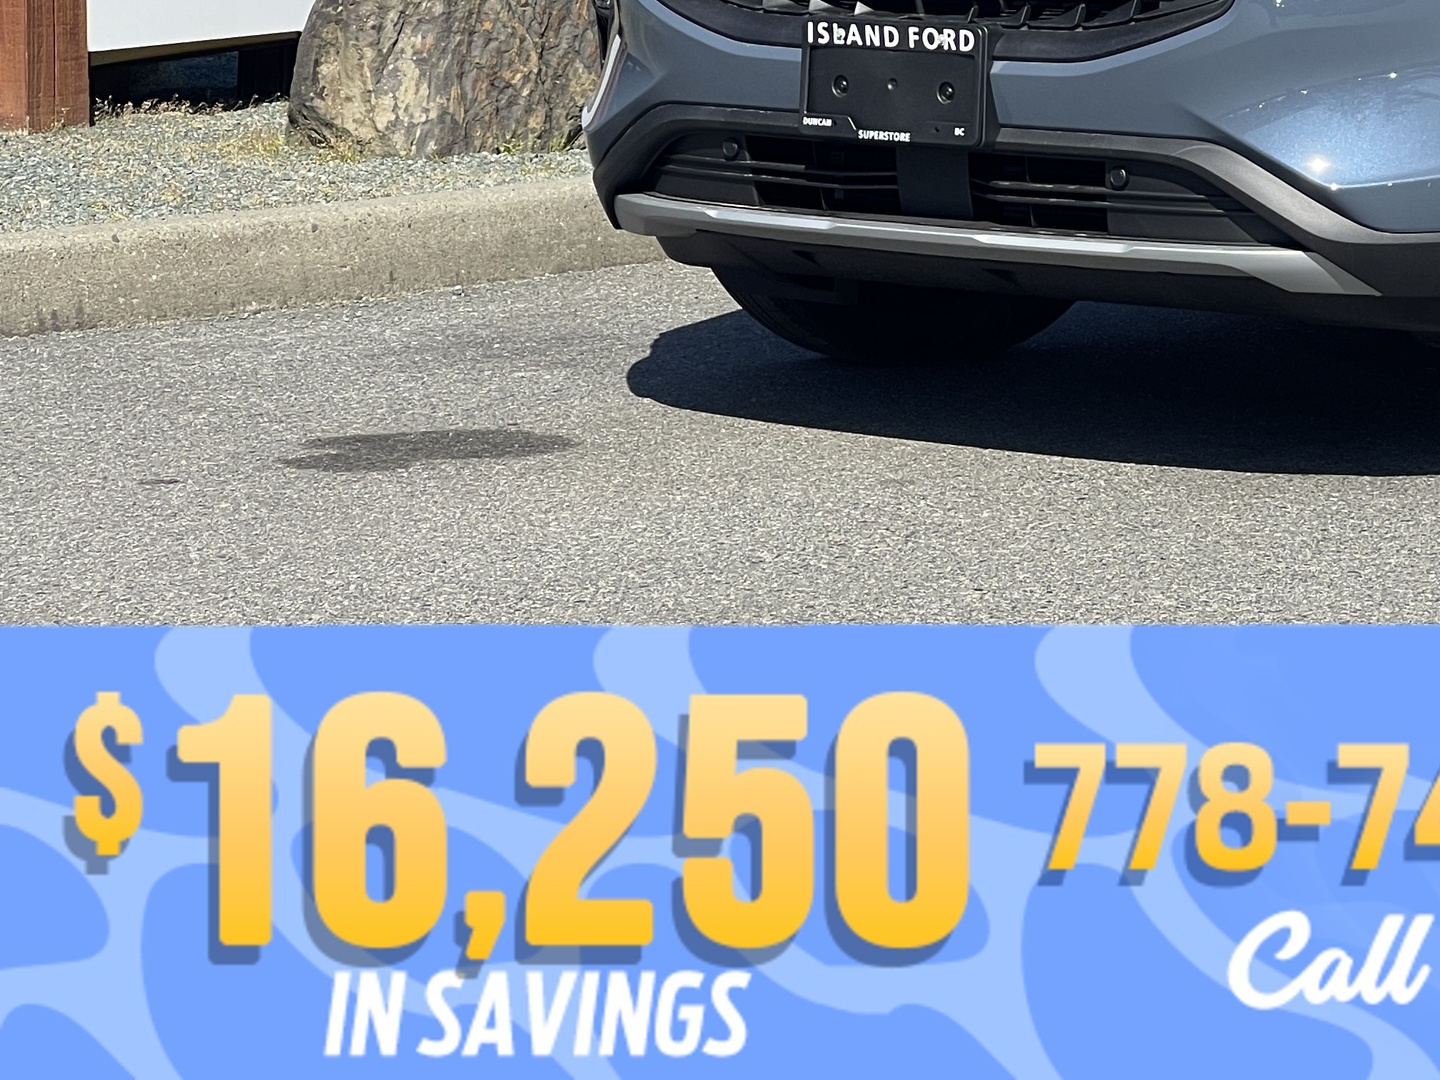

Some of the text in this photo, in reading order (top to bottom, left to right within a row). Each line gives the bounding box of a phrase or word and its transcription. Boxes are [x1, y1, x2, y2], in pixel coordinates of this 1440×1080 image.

[807, 21, 975, 52] ISLAND FORD
[802, 116, 833, 127] DUNCAN
[858, 129, 911, 142] SUPERSTORE
[954, 127, 965, 136] BC
